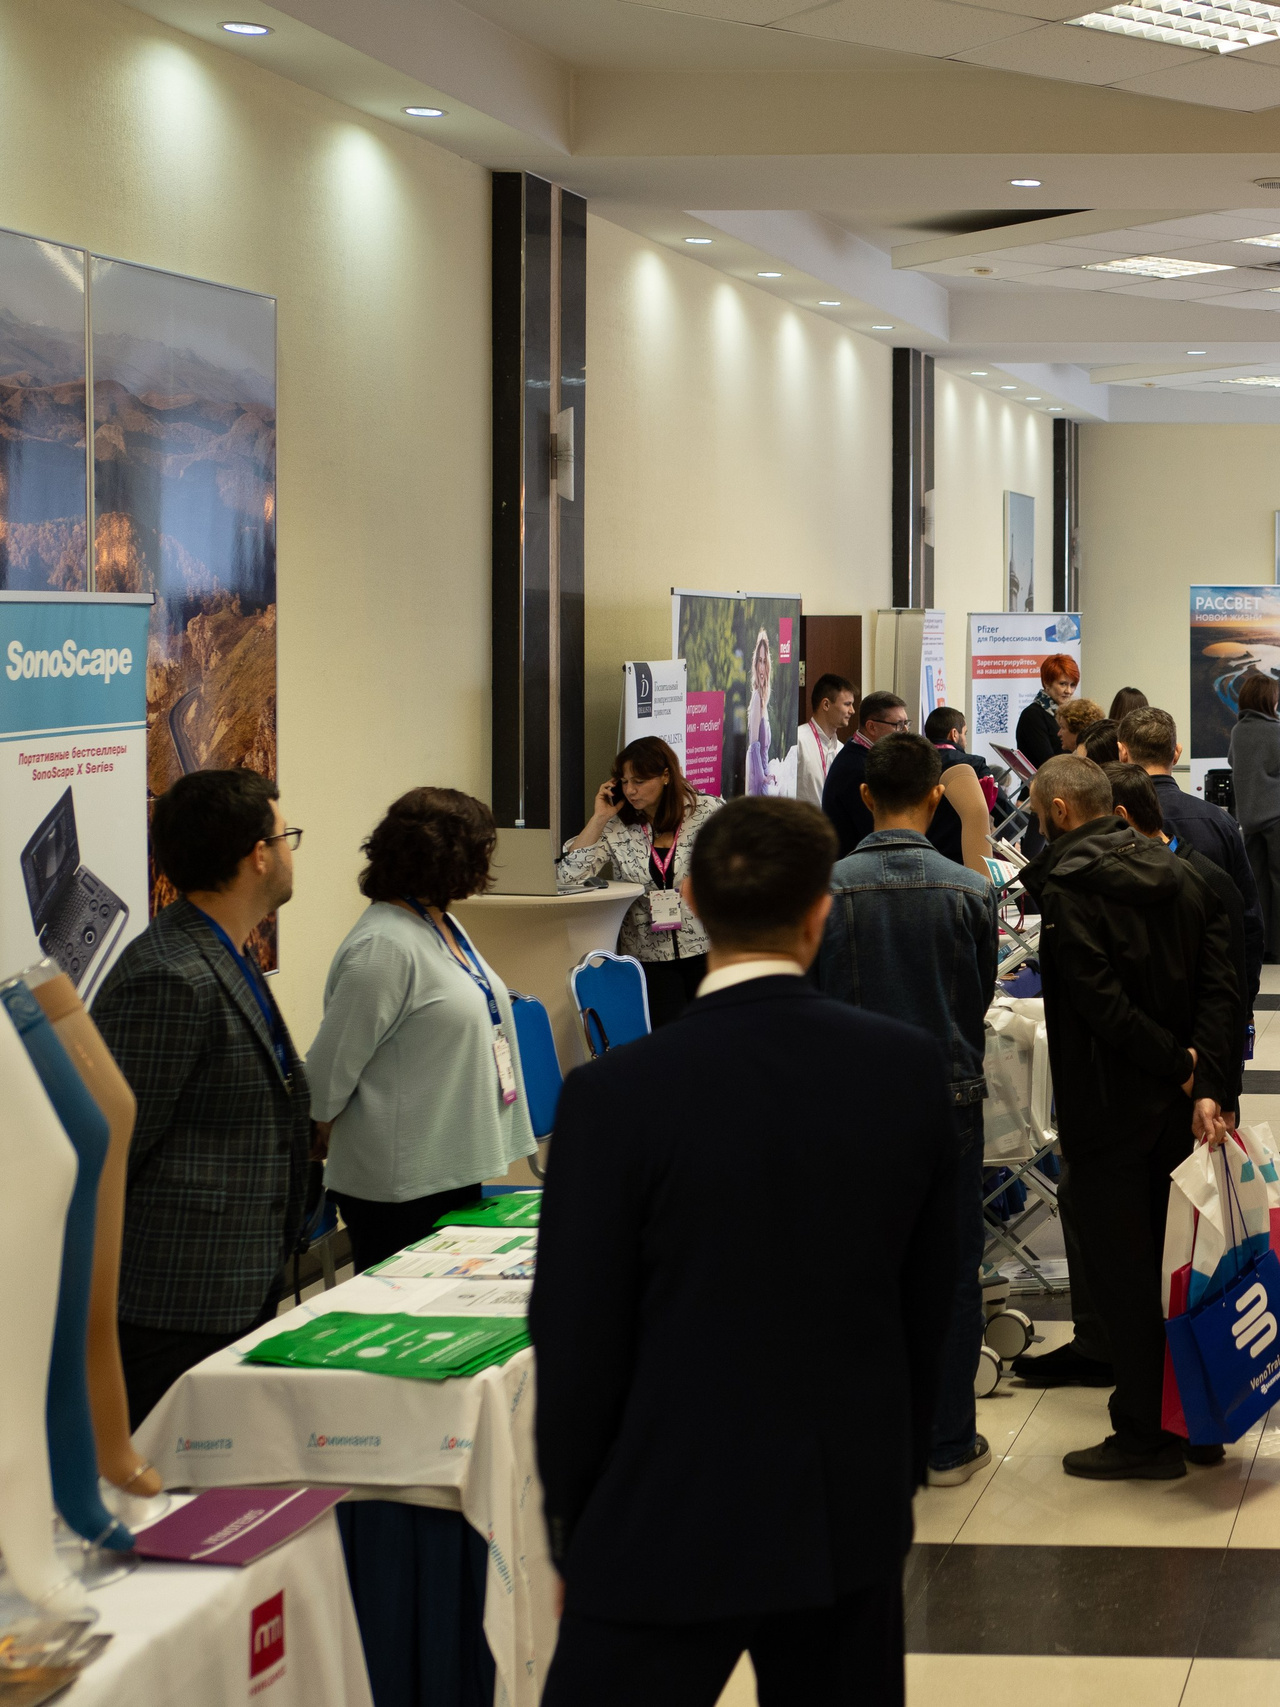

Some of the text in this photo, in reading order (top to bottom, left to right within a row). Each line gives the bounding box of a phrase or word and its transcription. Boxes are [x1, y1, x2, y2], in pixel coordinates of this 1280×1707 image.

[1195, 596, 1262, 610] РАССВЕТ
[1195, 612, 1262, 622] НОВОЙ ЖИЗНИ
[977, 625, 999, 634] Pfizer
[989, 635, 1042, 643] Профессионалов
[5, 638, 133, 685] SonoScape
[976, 659, 1037, 668] Зарегистрируйтесь
[18, 744, 128, 766] Портативные бестселлеры
[32, 761, 114, 781] SonoScape X Series
[307, 1432, 382, 1449] Доминанта
